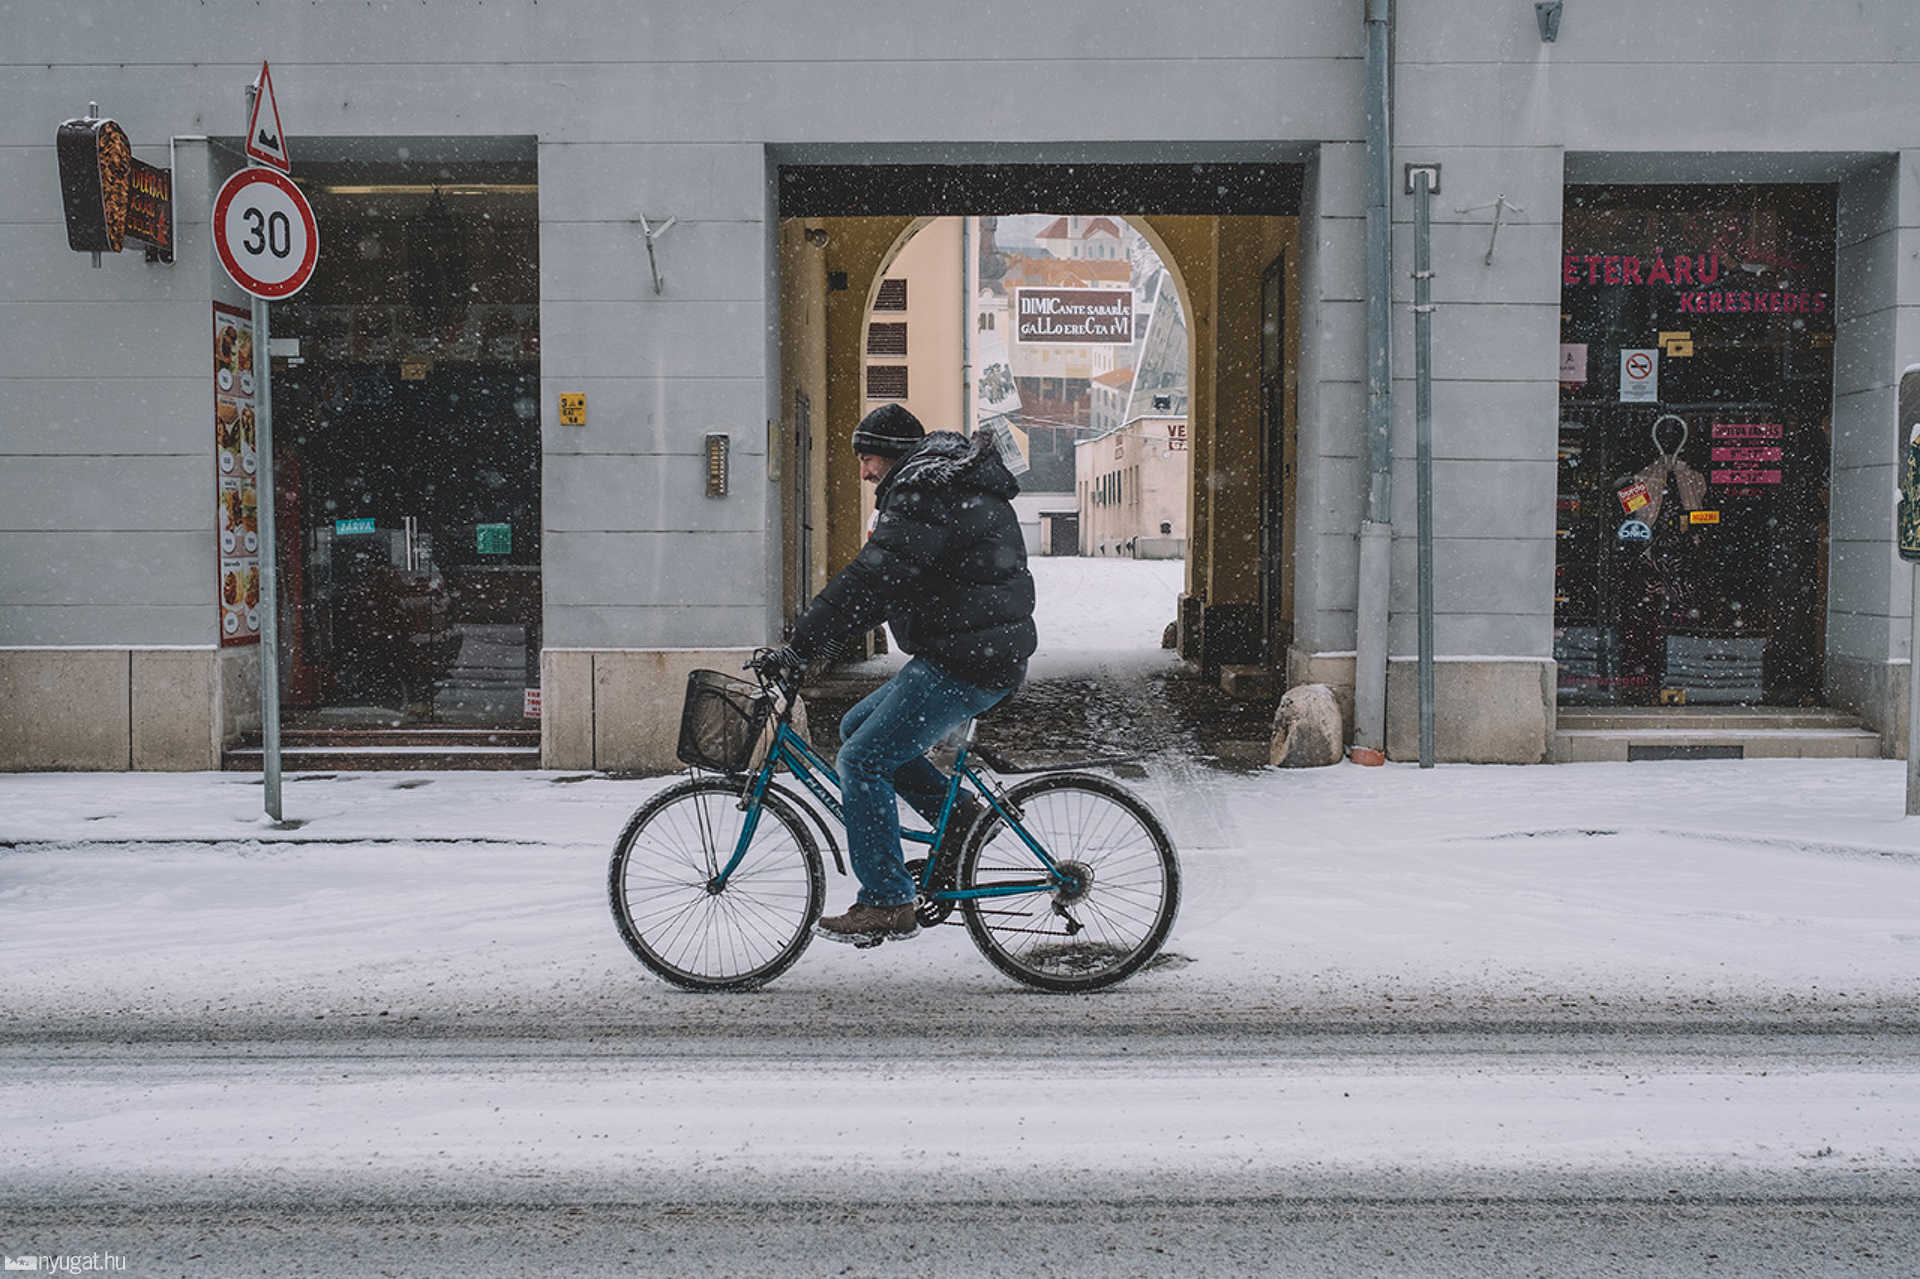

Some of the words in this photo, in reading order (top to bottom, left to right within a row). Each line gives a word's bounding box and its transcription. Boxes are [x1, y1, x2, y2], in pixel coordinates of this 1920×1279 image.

[243, 207, 291, 258] 30
[1563, 248, 1719, 285] ÉTERÁRU
[1167, 424, 1186, 437] VE
